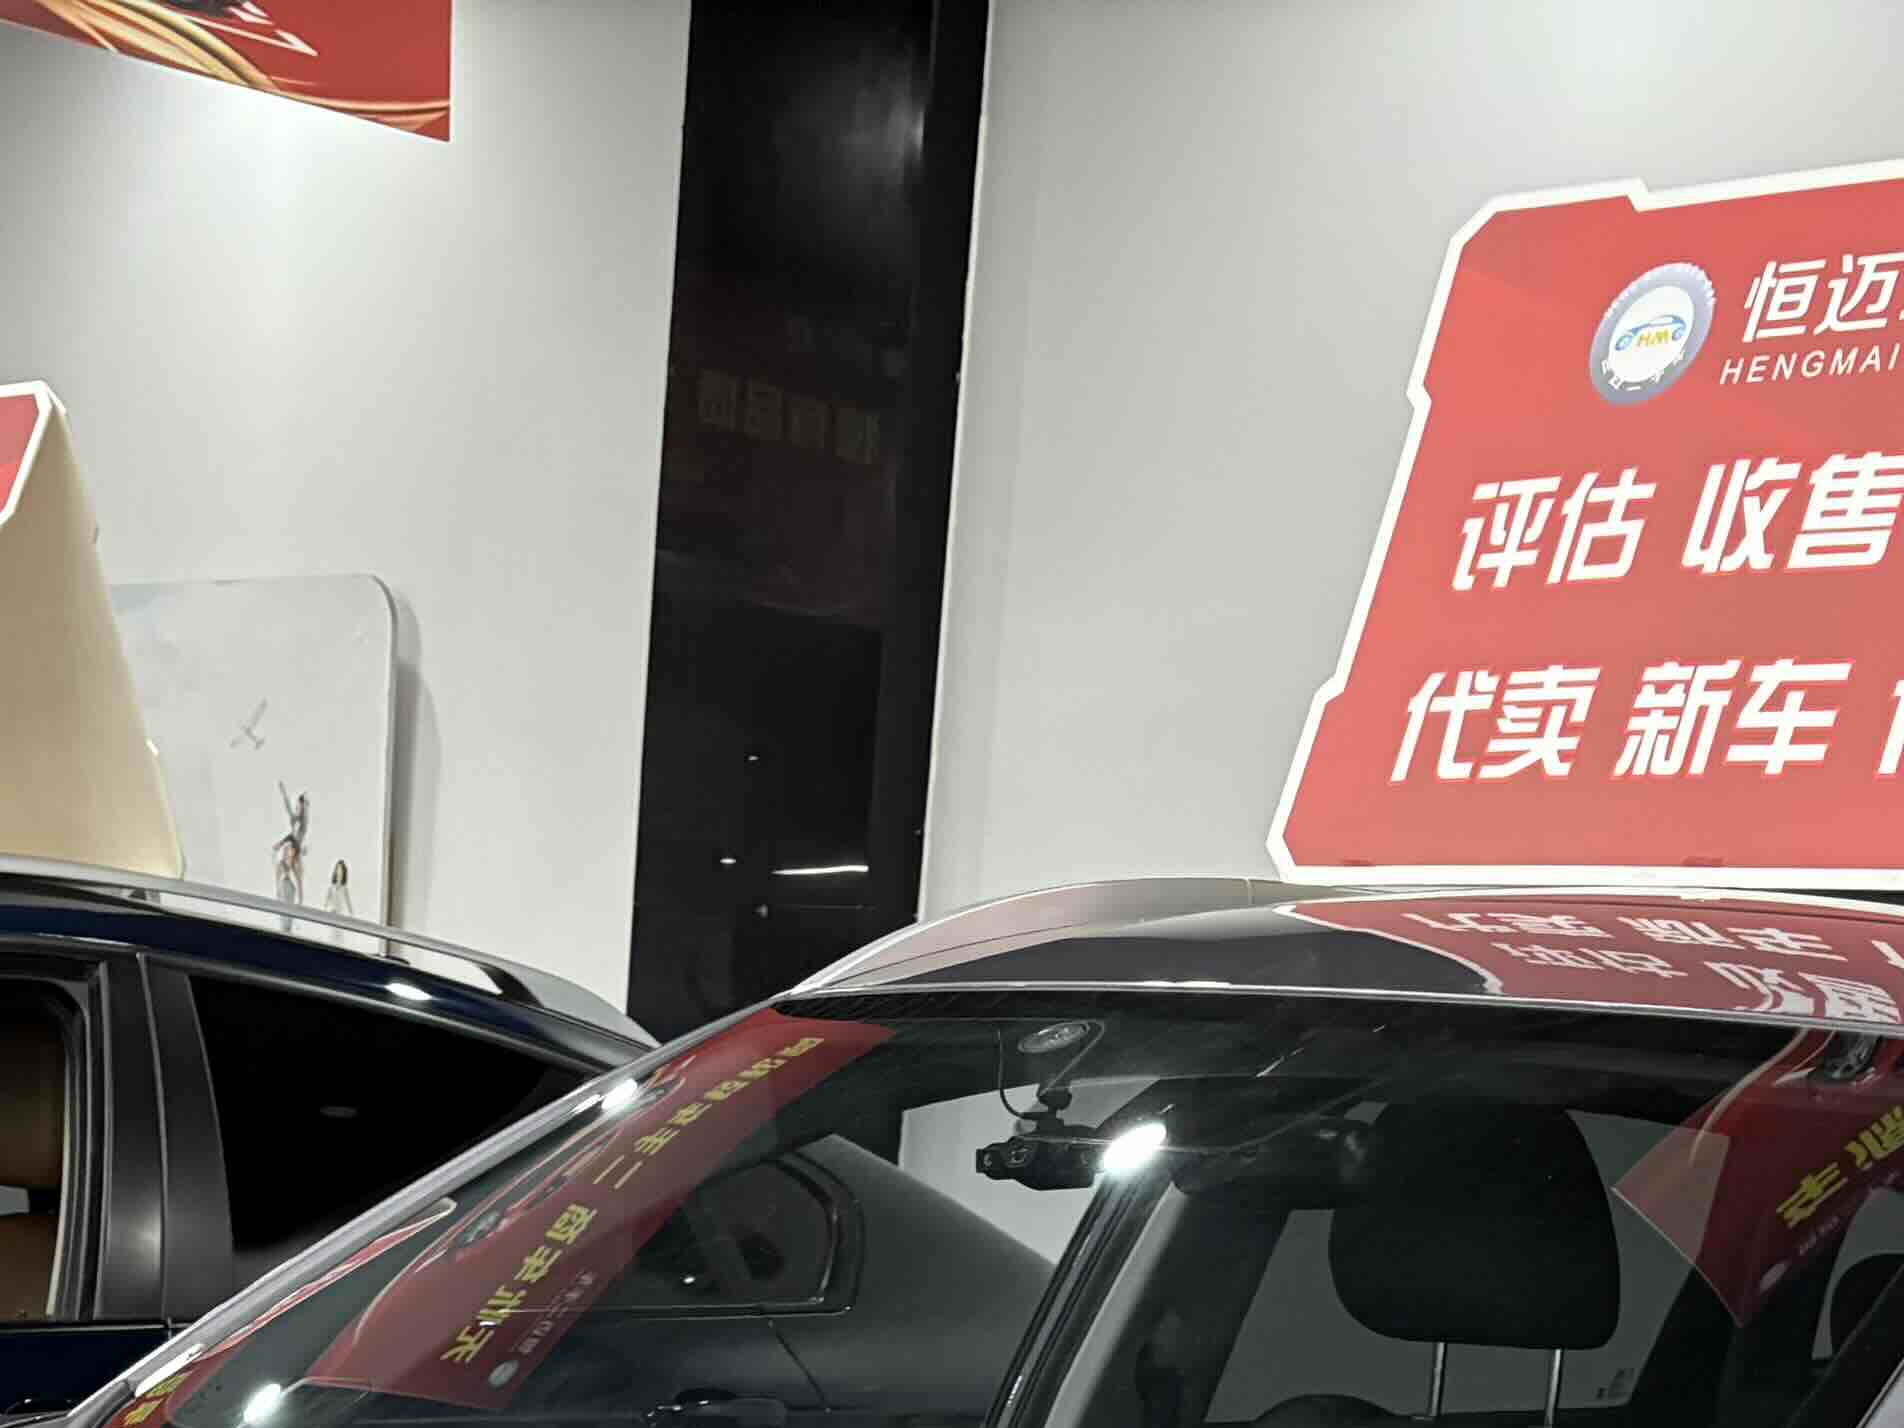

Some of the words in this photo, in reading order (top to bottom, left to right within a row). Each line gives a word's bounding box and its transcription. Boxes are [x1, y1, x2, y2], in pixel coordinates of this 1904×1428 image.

[1719, 343, 1899, 385] HENGMAI
[1451, 470, 1658, 591] 评估
[1390, 664, 1599, 781] 代卖
[1615, 659, 1849, 778] 新车
